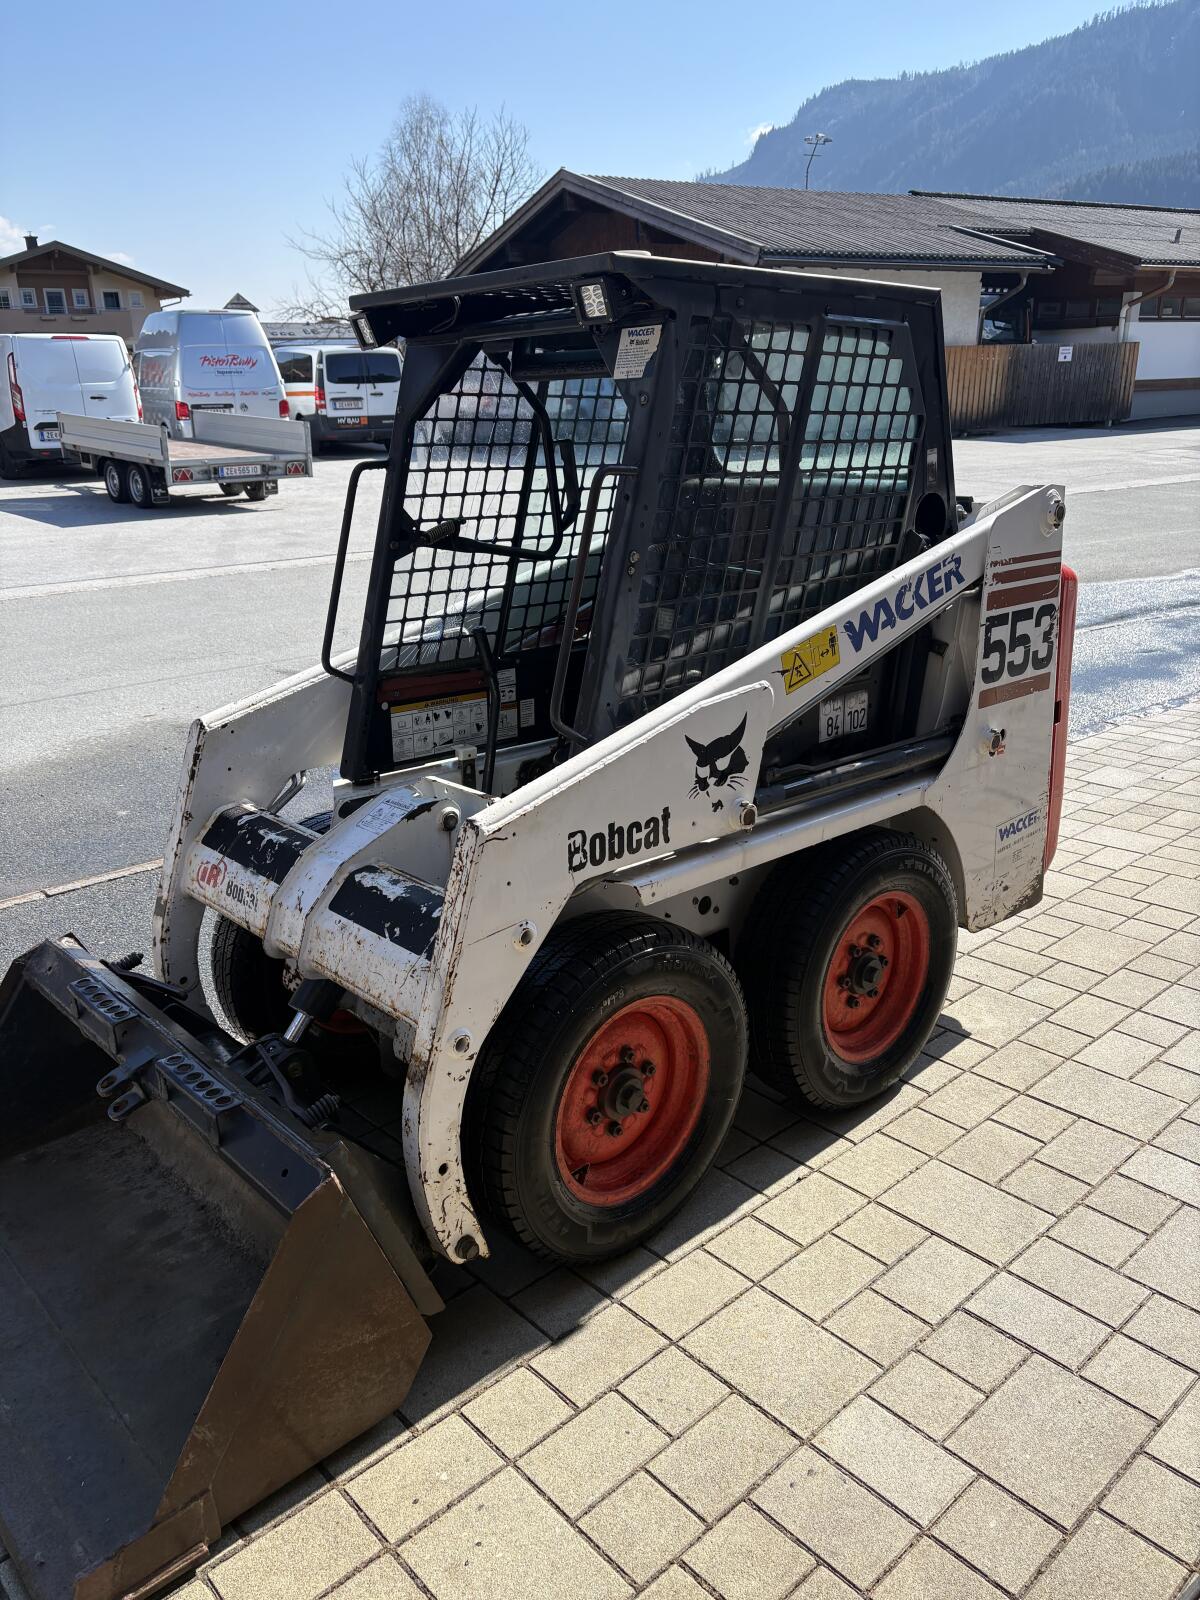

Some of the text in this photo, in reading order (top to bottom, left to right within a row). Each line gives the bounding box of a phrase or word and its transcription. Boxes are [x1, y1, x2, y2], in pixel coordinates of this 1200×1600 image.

[627, 327, 655, 338] WACKER
[843, 552, 966, 653] WACKER
[981, 602, 1058, 685] 553
[826, 708, 866, 737] 84 102
[567, 806, 671, 873] Bobcat
